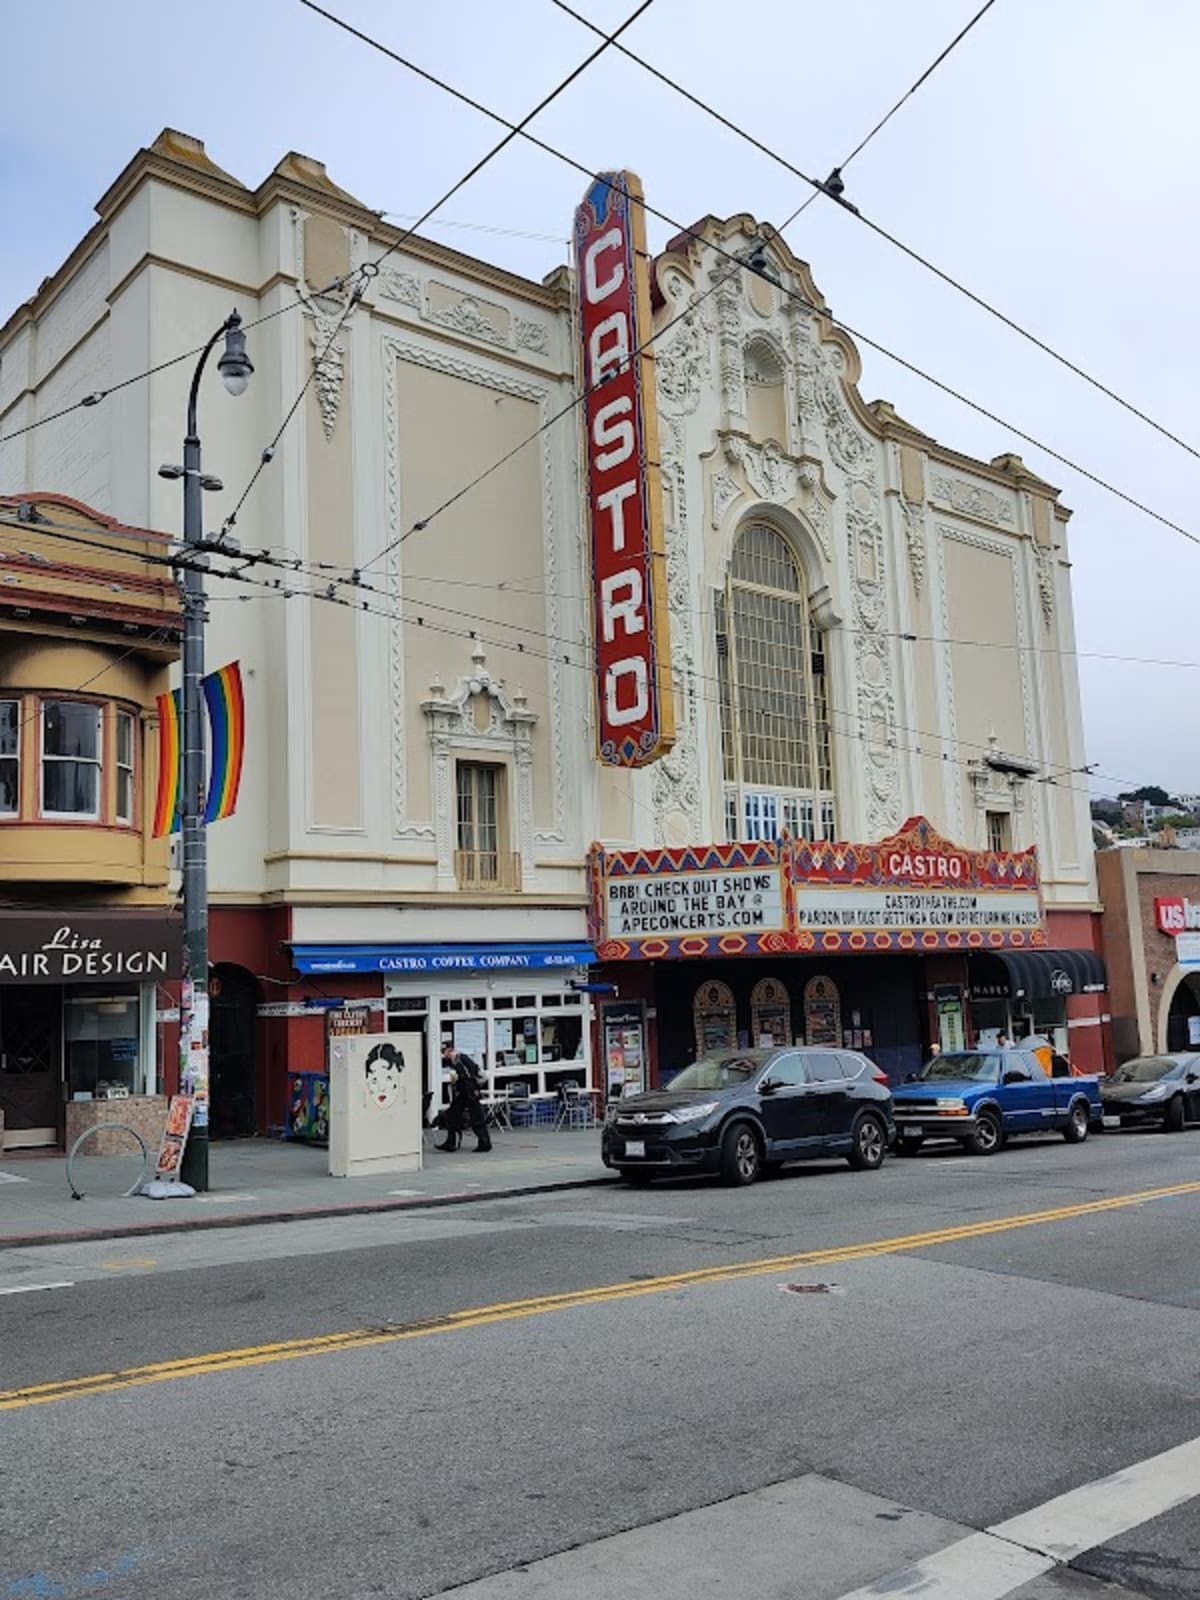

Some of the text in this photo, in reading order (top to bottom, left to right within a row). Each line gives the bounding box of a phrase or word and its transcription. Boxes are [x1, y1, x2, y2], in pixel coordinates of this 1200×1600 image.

[585, 227, 649, 727] CASTRO
[889, 853, 961, 879] CASTRO
[645, 882, 690, 898] CHECK
[693, 878, 718, 895] OUT
[723, 874, 772, 893] SHOWS
[620, 898, 676, 916] AROUND
[683, 895, 709, 912] THE
[716, 893, 746, 909] BAY
[621, 910, 764, 933] APECONCERTS.COM
[41, 926, 104, 951] Lisa
[62, 951, 167, 975] DESIGN
[379, 957, 427, 969] CASTRO
[432, 956, 477, 968] COFFEE
[480, 955, 530, 967] COMPANY
